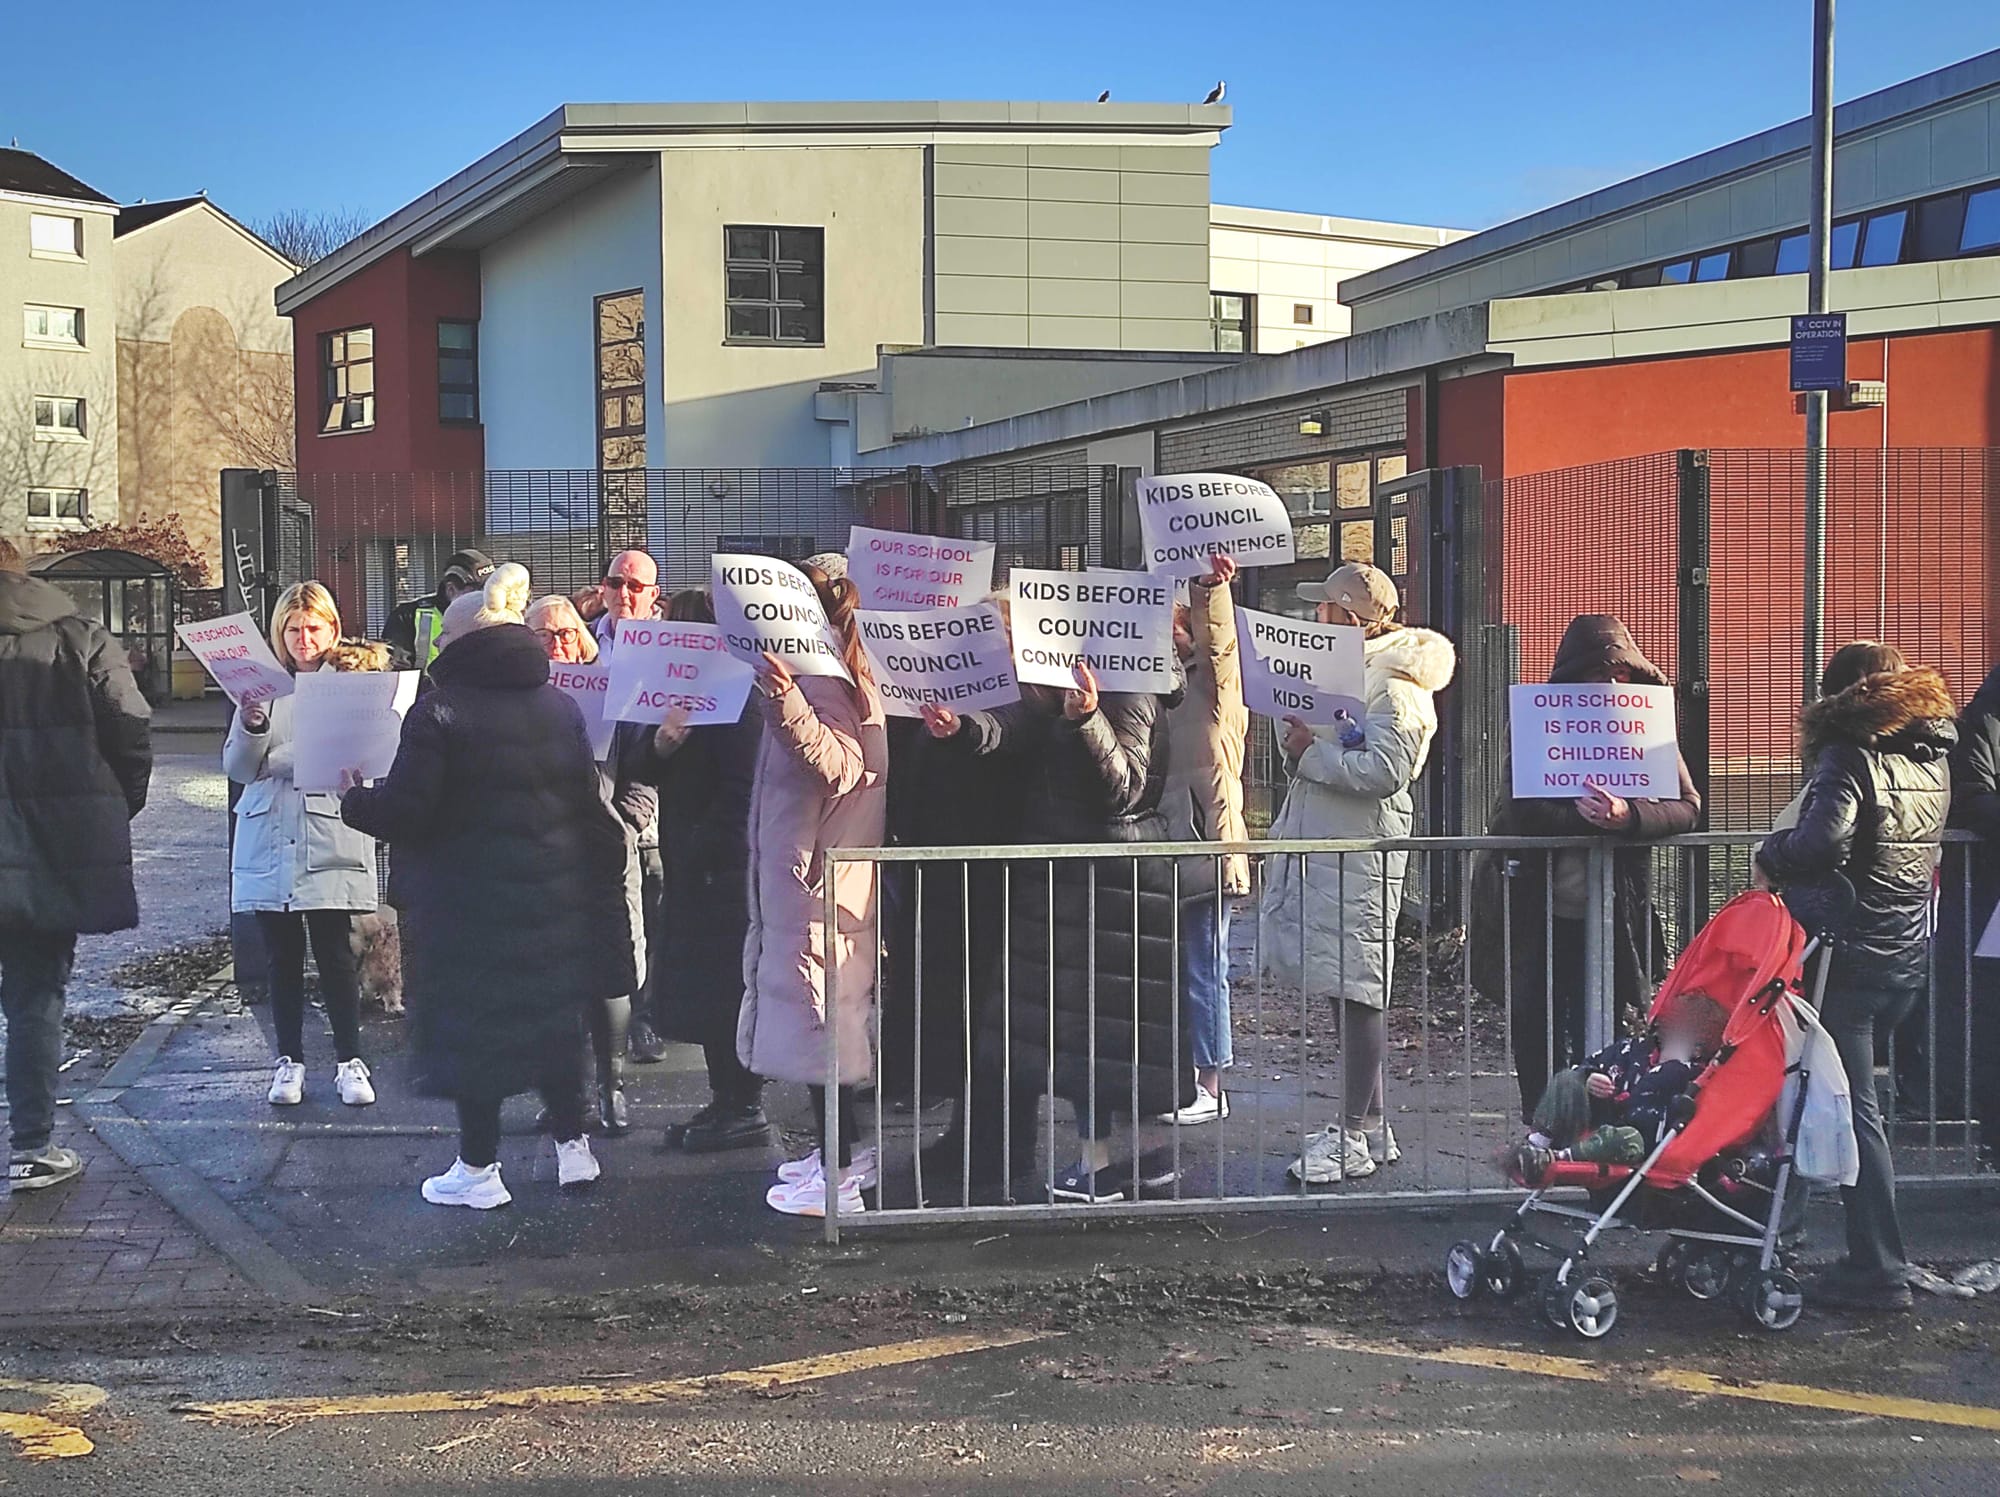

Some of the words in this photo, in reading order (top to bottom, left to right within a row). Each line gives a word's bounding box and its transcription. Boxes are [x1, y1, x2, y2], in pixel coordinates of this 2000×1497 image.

[1795, 330, 1841, 339] OPERATION
[1808, 320, 1832, 329] CCTV
[1833, 319, 1842, 328] IN
[1146, 484, 1194, 505] KIDS
[1198, 482, 1272, 498] BEFORE
[1169, 507, 1264, 533] COUNCIL
[870, 539, 903, 555] OUR
[907, 544, 974, 563] SCHOOL
[1154, 533, 1287, 563] CONVENIENCE
[722, 567, 774, 586] KIDS
[876, 563, 890, 576] IS
[894, 566, 924, 581] FOR
[928, 570, 963, 585] OUR
[875, 586, 958, 608] CHILDREN
[1019, 581, 1070, 602] KIDS
[1076, 585, 1165, 606] BEFORE
[203, 624, 244, 641] SCHOOL
[623, 630, 652, 646] NO
[862, 621, 905, 641] KIDS
[909, 614, 995, 641] BEFORE
[1038, 617, 1143, 640] COUNCIL
[1255, 622, 1336, 652] PROTECT
[227, 645, 250, 659] OUR
[727, 633, 840, 660] CONVENIEN
[667, 662, 698, 680] NO
[887, 651, 982, 674] COUNCIL
[1022, 648, 1164, 673] CONVENIENCE
[1273, 658, 1312, 681] OUR
[880, 673, 1010, 703] CONVENIENCE
[1273, 687, 1314, 711] KIDS
[637, 691, 718, 712] ACCESS
[1534, 694, 1573, 708] OUR
[1577, 694, 1653, 709] SCHOOL
[1545, 720, 1561, 733] IS
[1567, 720, 1602, 733] FOR
[1607, 720, 1645, 734] OUR
[1548, 747, 1644, 761] CHILDREN
[1544, 773, 1579, 786] NOT
[1584, 773, 1649, 787] ADULTS
